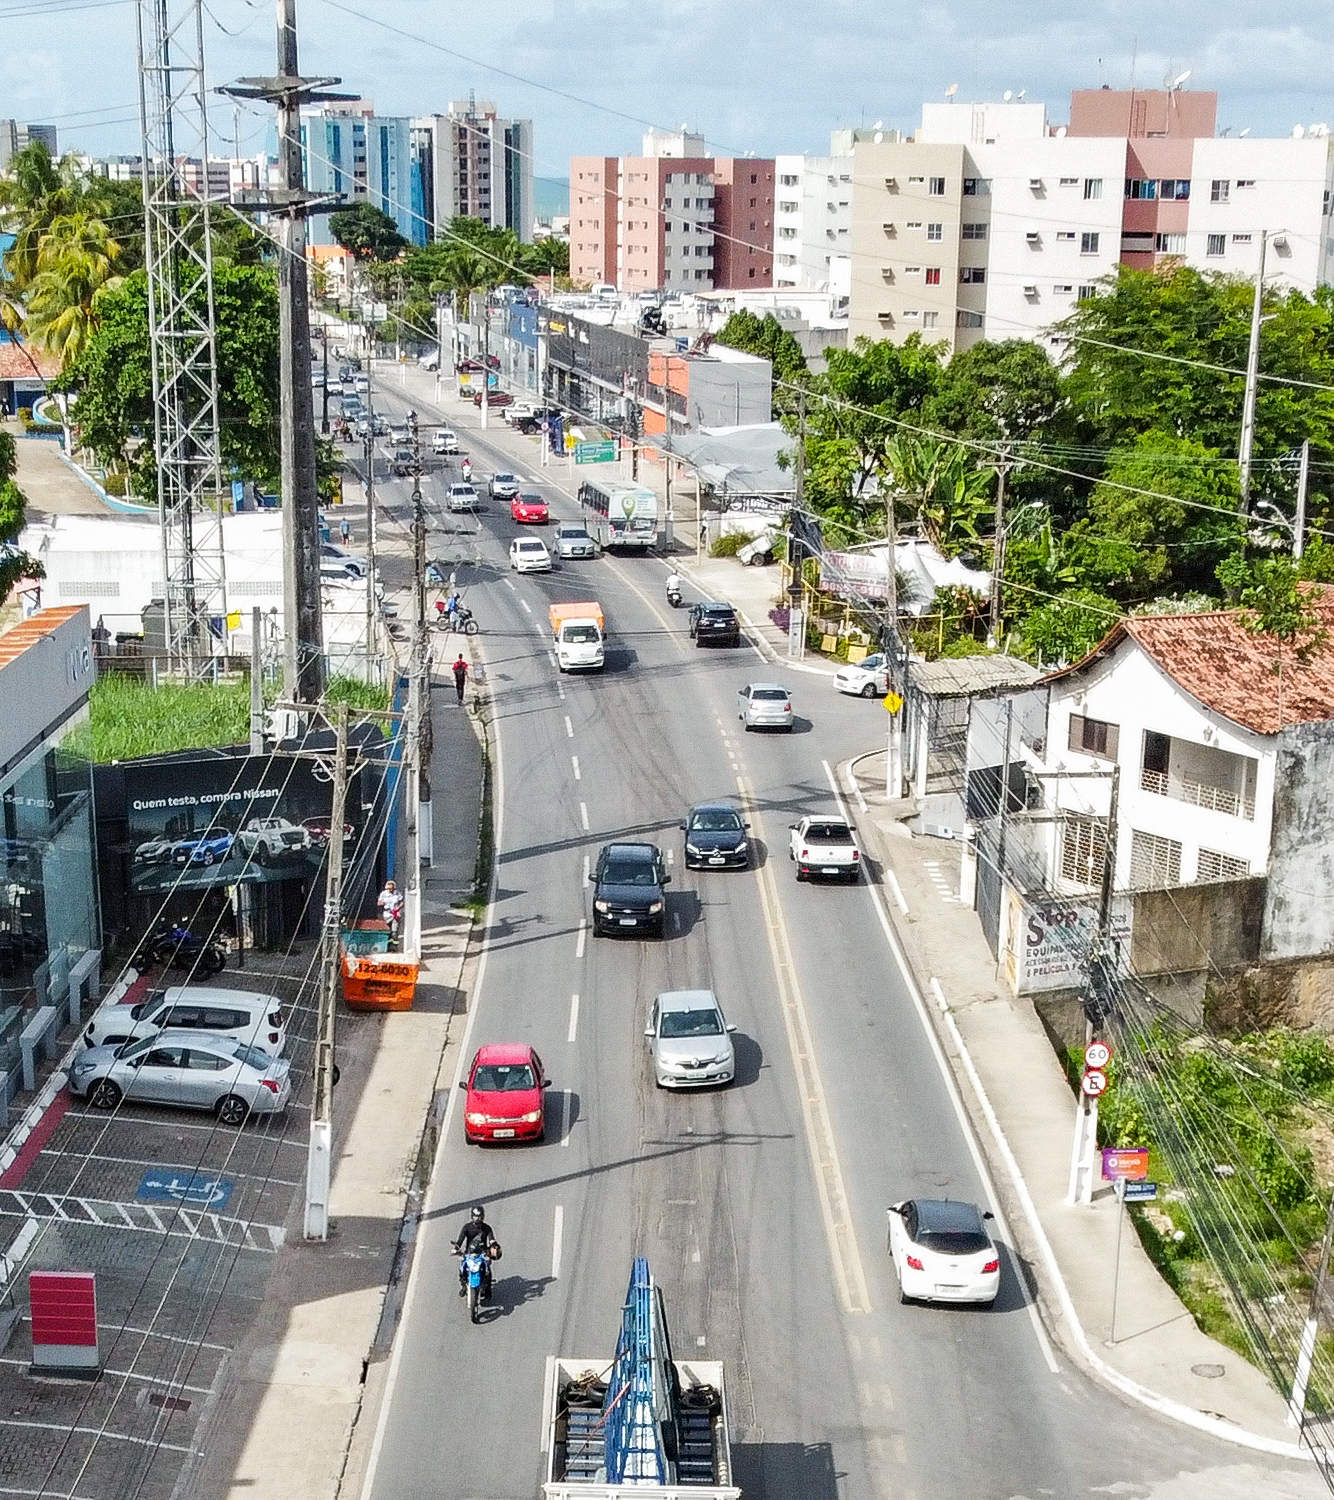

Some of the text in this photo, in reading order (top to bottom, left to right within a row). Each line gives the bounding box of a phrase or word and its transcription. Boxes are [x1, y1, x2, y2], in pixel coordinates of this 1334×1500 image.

[133, 787, 280, 811] Quem testa, compra Nissan
[1088, 1049, 1106, 1060] 60
